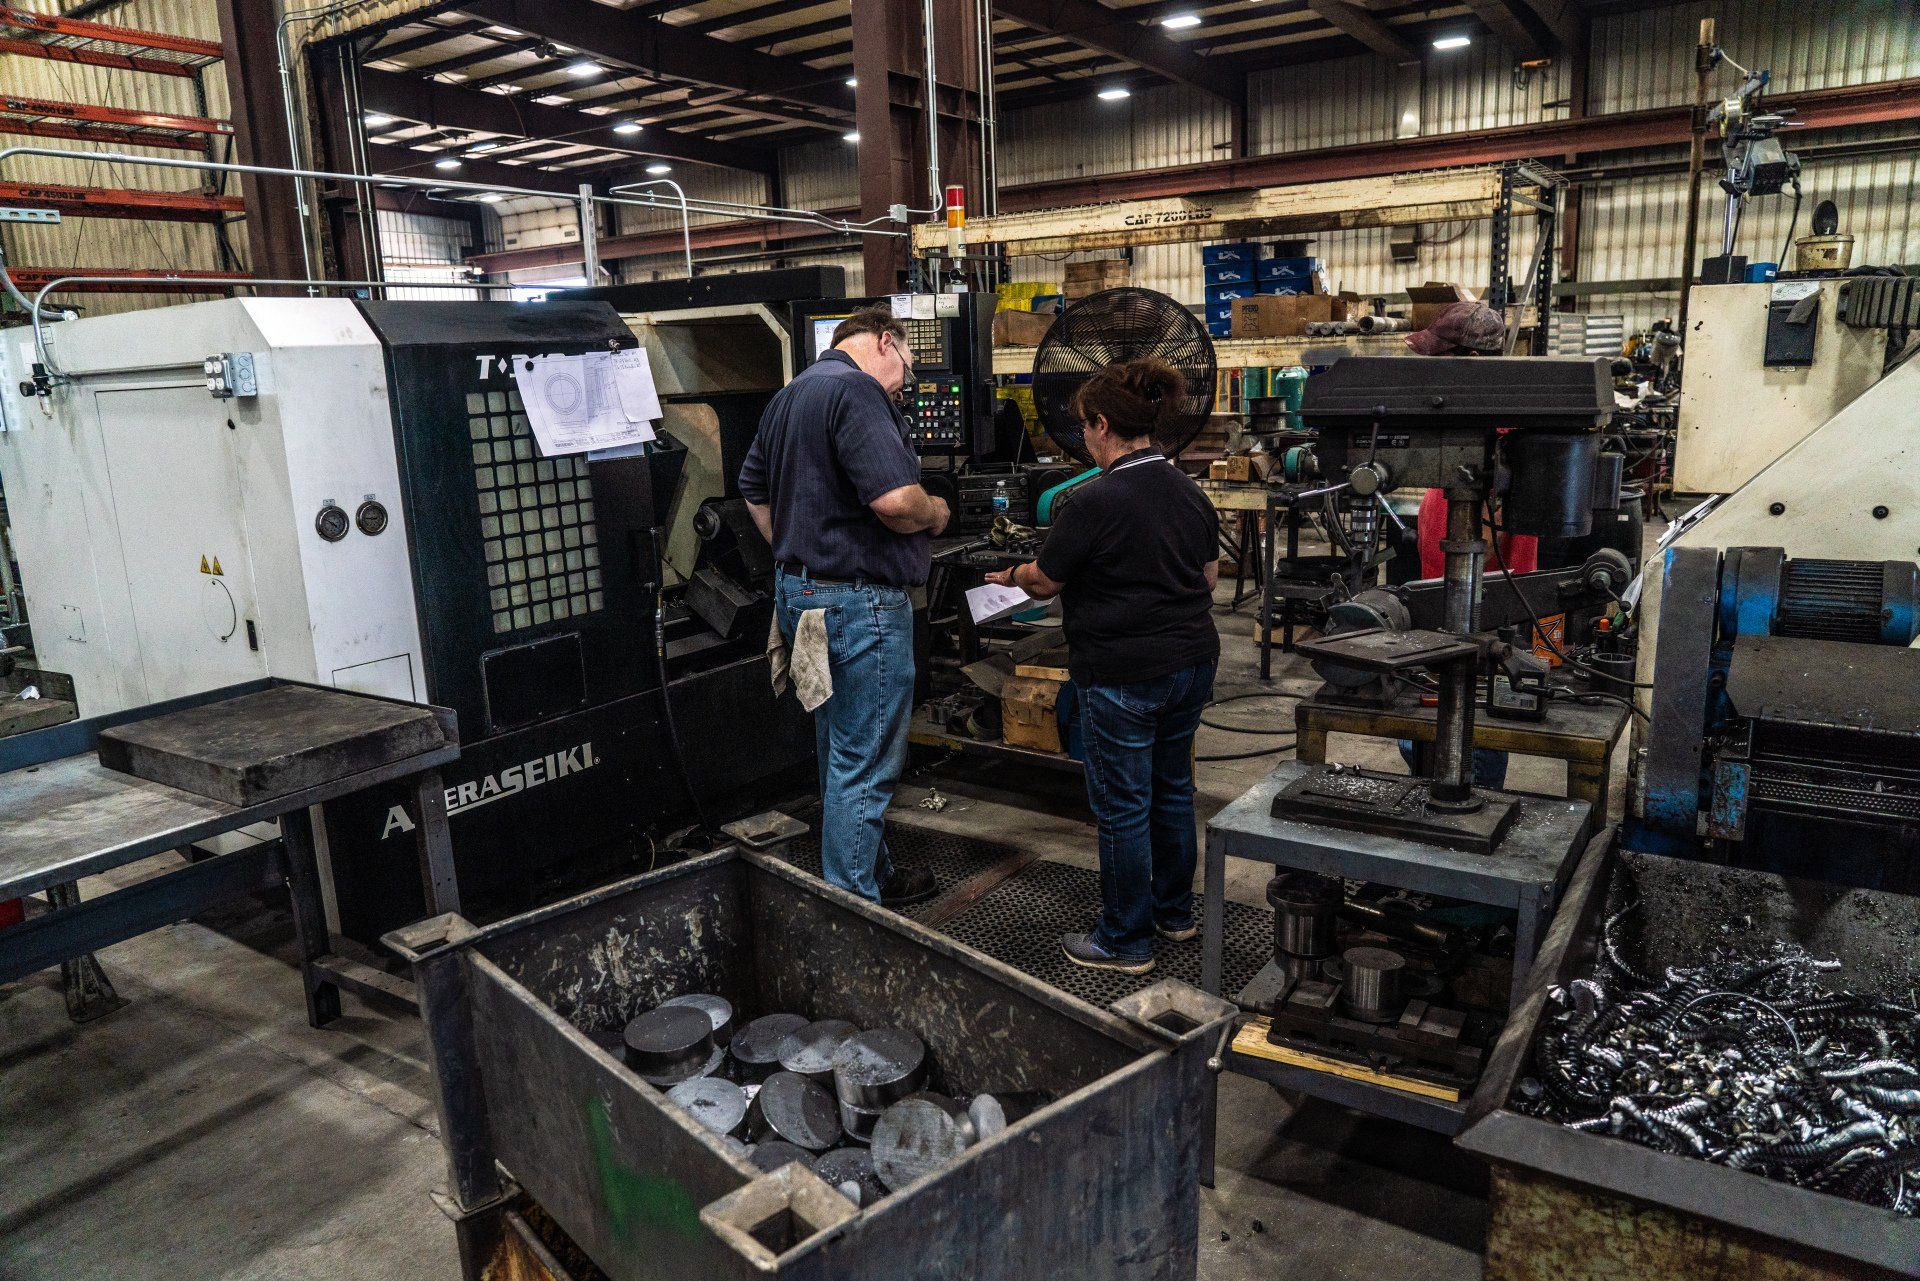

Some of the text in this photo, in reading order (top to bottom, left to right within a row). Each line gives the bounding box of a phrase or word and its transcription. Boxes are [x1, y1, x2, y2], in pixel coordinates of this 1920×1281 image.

[20, 189, 41, 197] CAP
[1125, 213, 1152, 226] CAP
[17, 273, 40, 281] CAP
[381, 741, 594, 840] AERASEIKI
